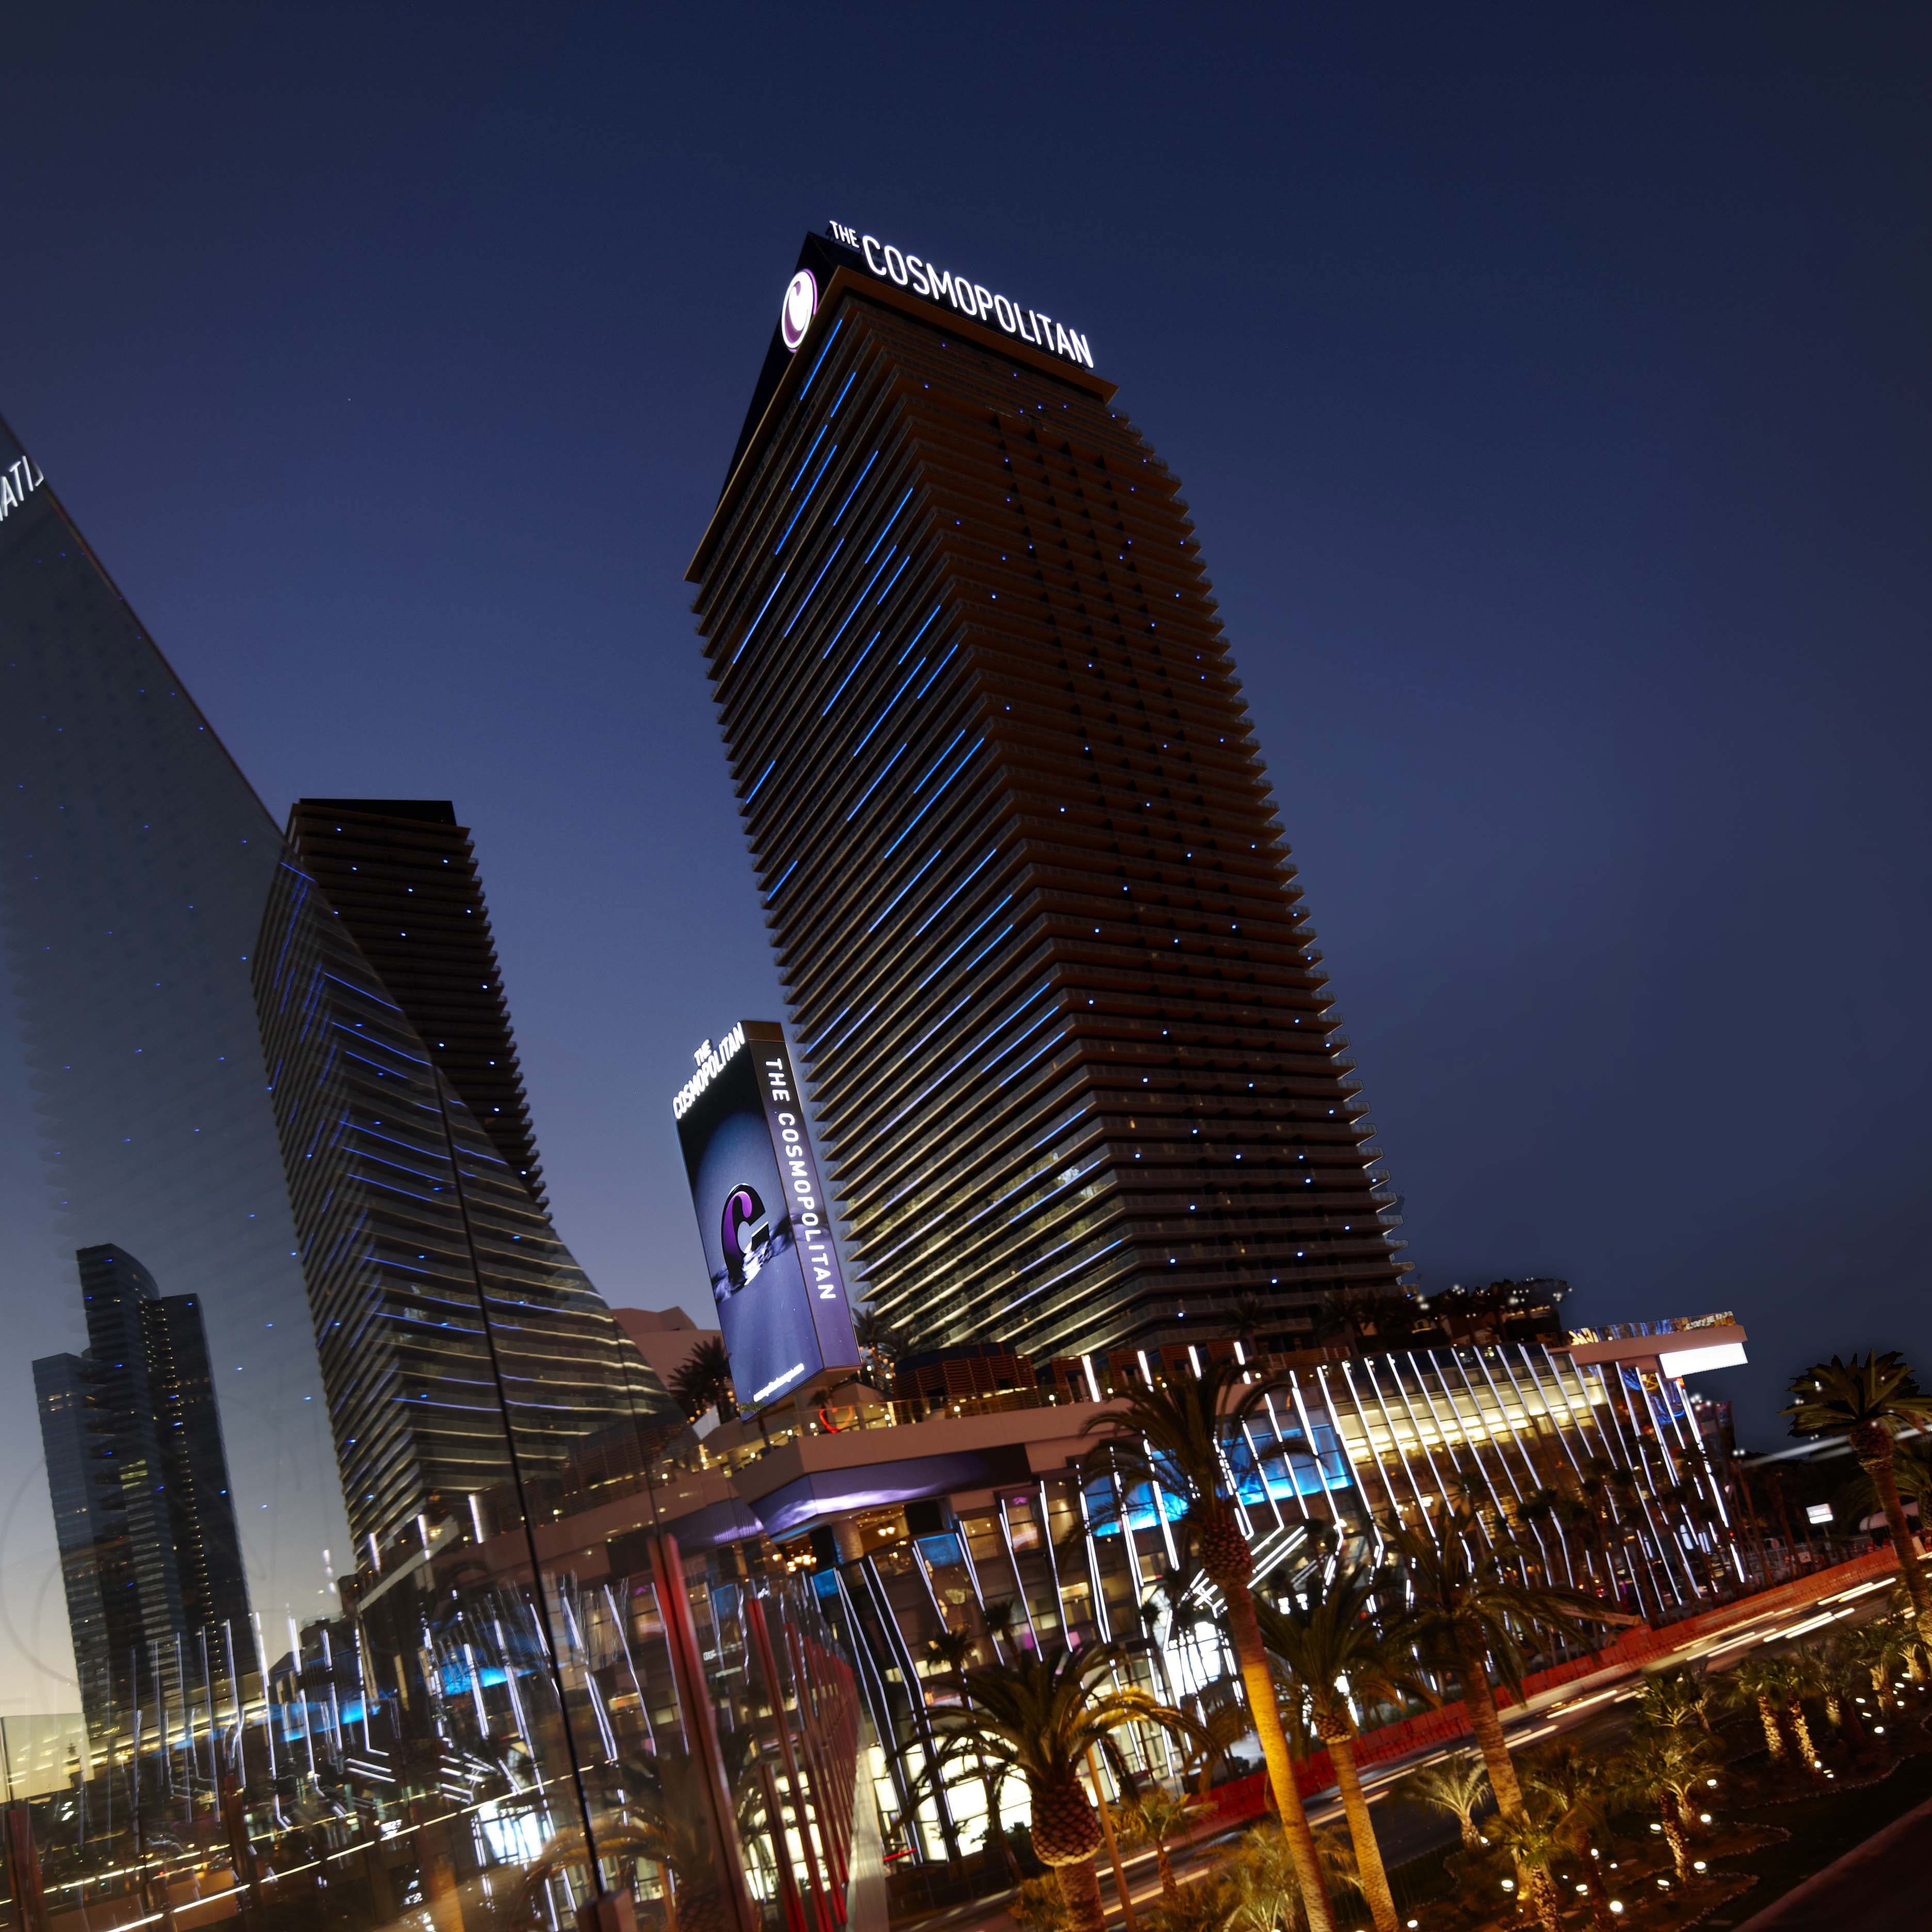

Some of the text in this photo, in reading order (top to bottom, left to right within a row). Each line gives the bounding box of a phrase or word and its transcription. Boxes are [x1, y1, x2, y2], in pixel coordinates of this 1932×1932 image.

[829, 220, 1094, 368] THE COSMOPOLITAN
[672, 1022, 745, 1119] COSMOPOLITAN
[694, 1039, 712, 1067] THE
[765, 1057, 837, 1300] THE COSMOPOLITAN
